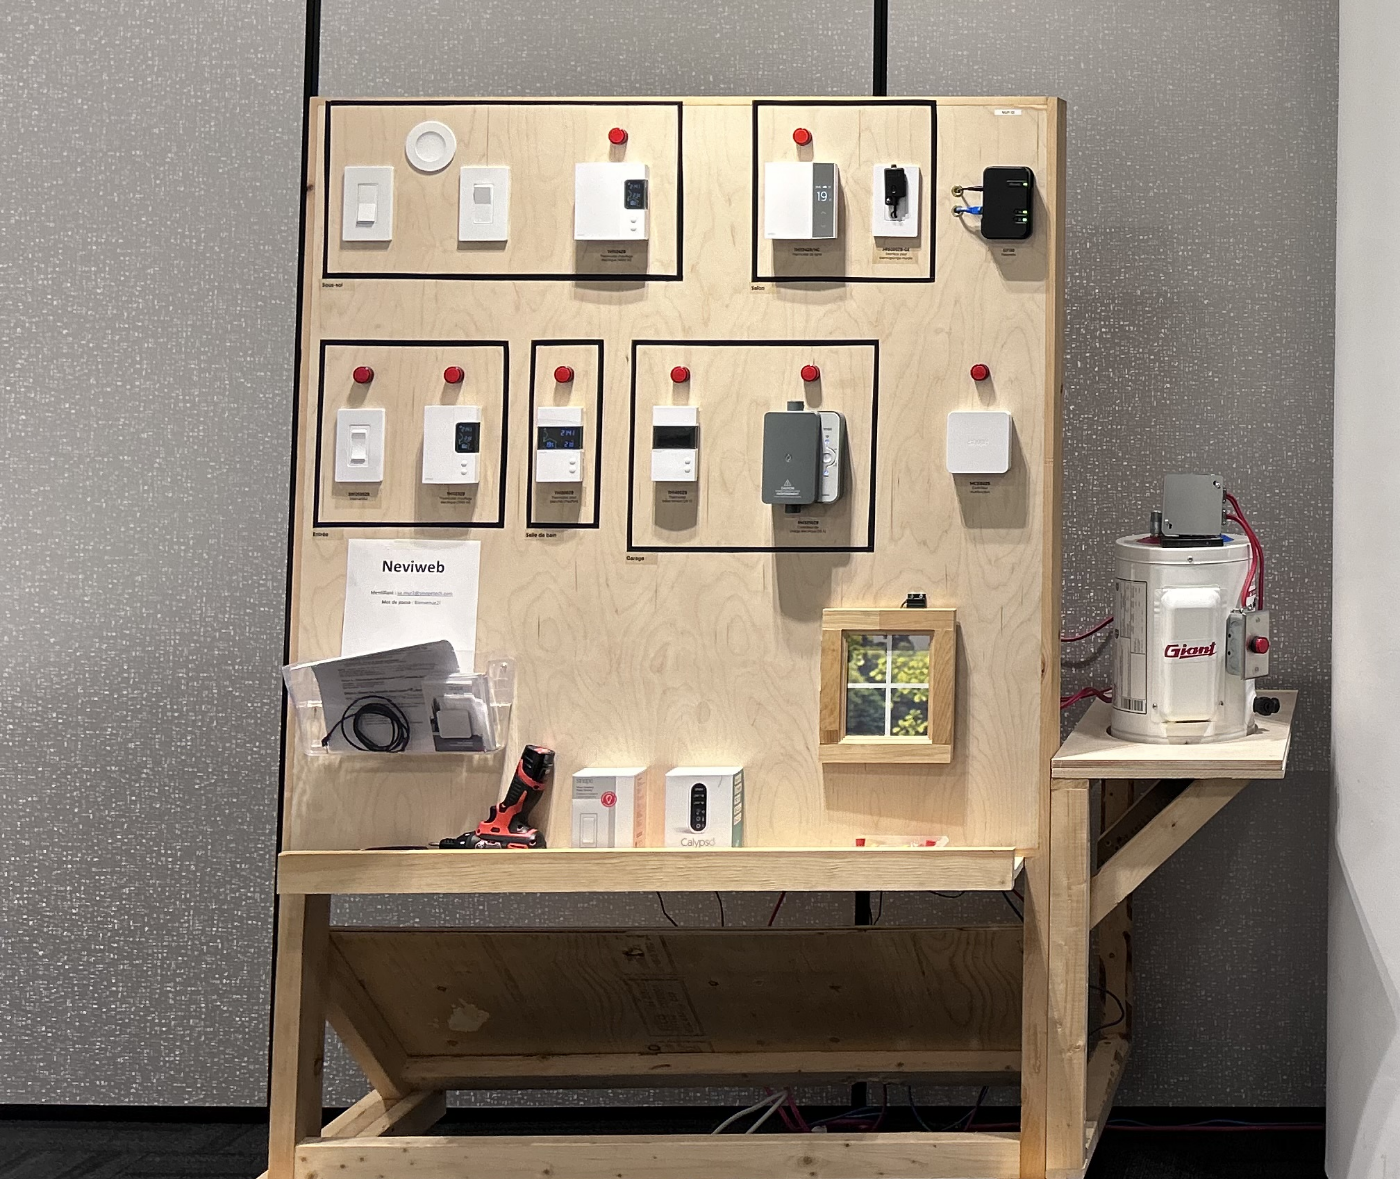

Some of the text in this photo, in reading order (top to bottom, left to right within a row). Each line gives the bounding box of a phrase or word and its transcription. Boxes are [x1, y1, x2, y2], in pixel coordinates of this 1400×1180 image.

[816, 191, 828, 202] 19
[382, 560, 445, 573] Neviweb
[1164, 642, 1218, 659] Giant
[680, 837, 715, 848] Calypso
